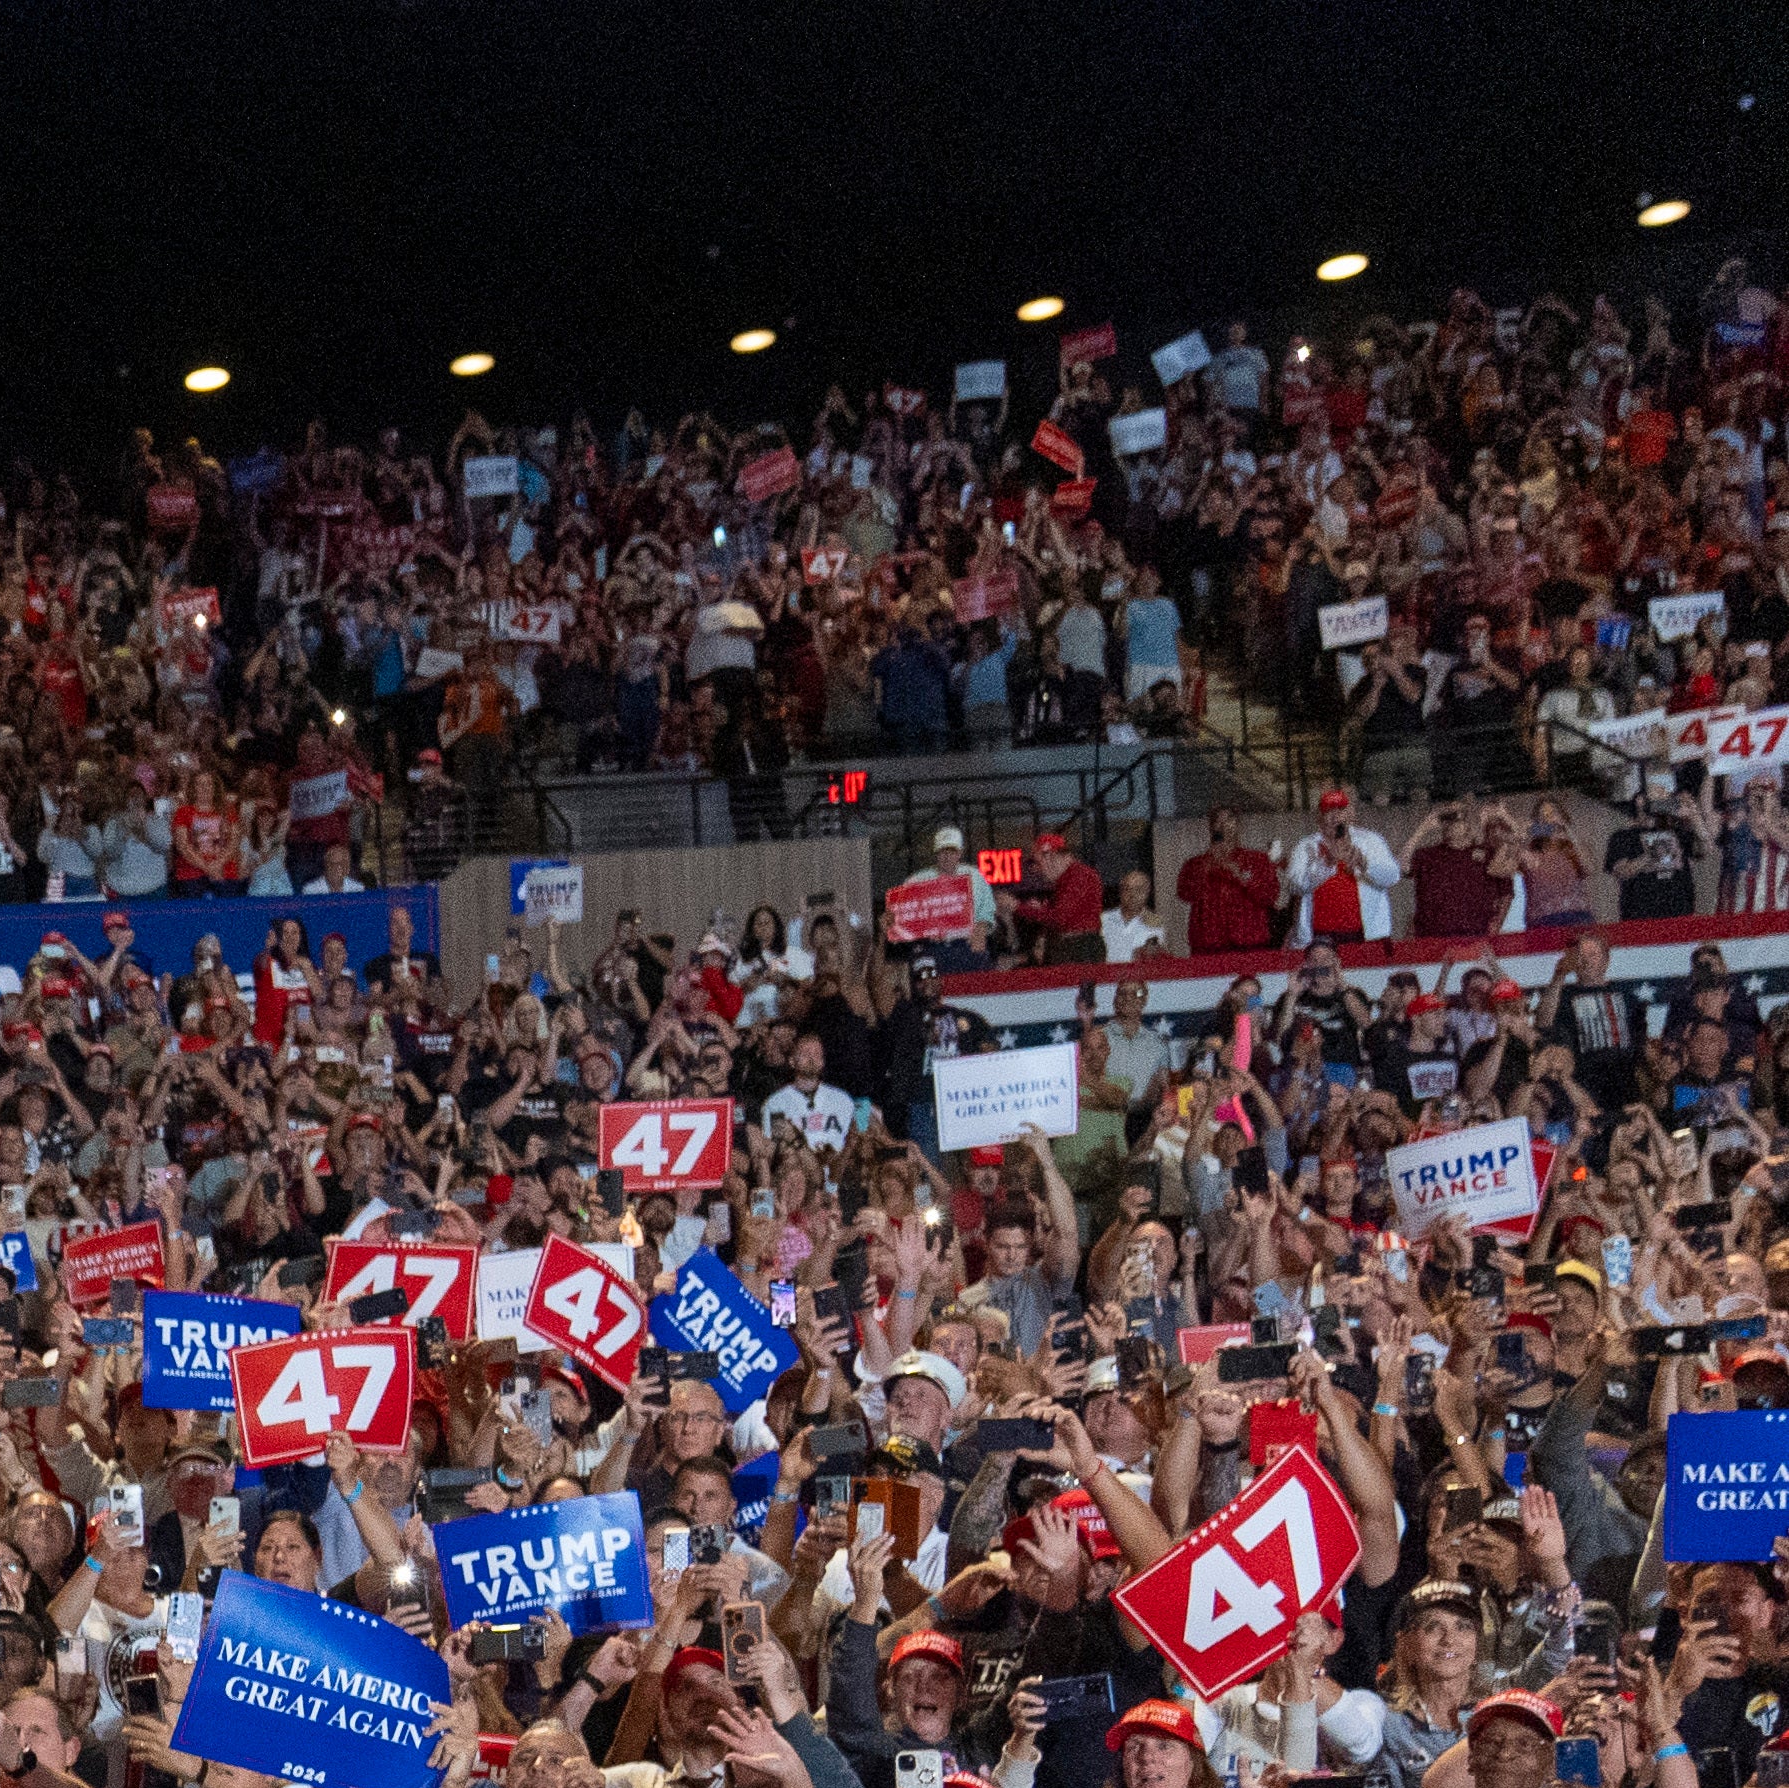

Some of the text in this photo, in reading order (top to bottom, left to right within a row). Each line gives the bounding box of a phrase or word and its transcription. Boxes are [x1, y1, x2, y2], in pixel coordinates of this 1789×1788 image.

[809, 551, 847, 578] 47
[511, 611, 551, 632] 47
[1719, 718, 1787, 758] 47
[978, 849, 1022, 884] EXIT
[945, 1075, 1069, 1103] MAKE AMERICA
[955, 1094, 1059, 1118] GREAT AGAIN
[611, 1112, 716, 1176] 47
[1399, 1146, 1520, 1194] TRUMP
[1414, 1170, 1509, 1206] VANCE
[73, 1242, 158, 1270] MAKE AMERICA
[337, 1253, 460, 1326] 47
[487, 1287, 531, 1305] MAK
[544, 1267, 640, 1362] 47
[677, 1271, 777, 1378] TRUMP
[674, 1302, 753, 1384] VANCE
[256, 1344, 395, 1434] 47
[1683, 1463, 1764, 1484] MAKE
[1697, 1490, 1789, 1510] GREAT
[452, 1527, 632, 1585] TRUMP
[1183, 1476, 1328, 1656] 47
[476, 1561, 619, 1607] VANCE
[472, 1604, 501, 1617] MAKE
[504, 1598, 552, 1614] AMERICA
[217, 1636, 435, 1715] MAKE AMERIC
[225, 1676, 423, 1750] GREAT AGAIN
[281, 1761, 325, 1784] 2024
